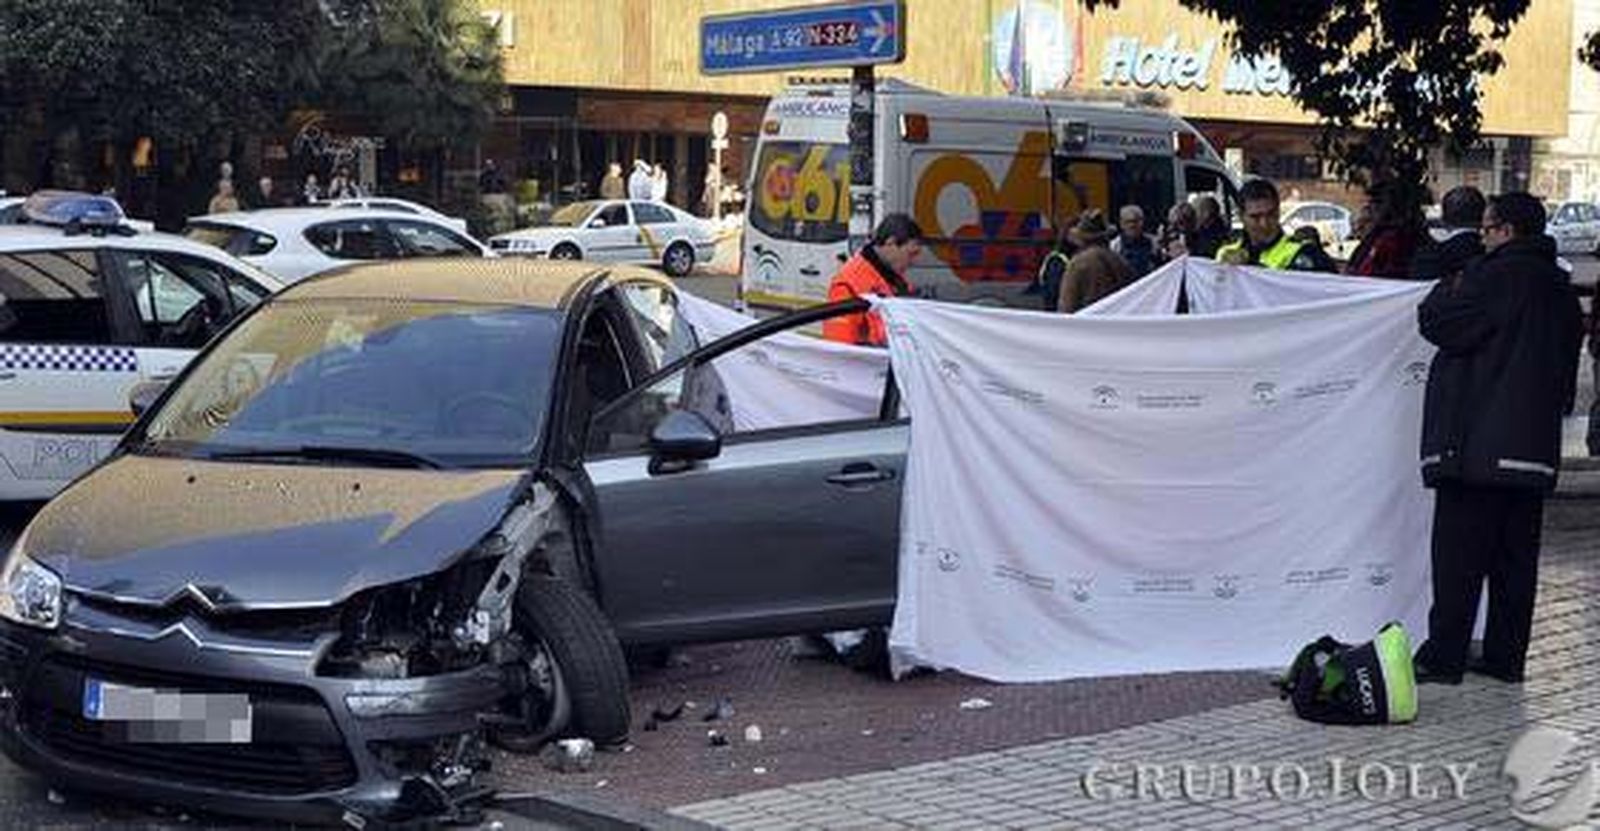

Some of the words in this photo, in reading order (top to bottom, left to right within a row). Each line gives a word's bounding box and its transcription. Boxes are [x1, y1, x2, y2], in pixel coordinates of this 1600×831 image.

[706, 32, 764, 58] Málaga
[806, 22, 858, 46] N-334
[1102, 35, 1217, 90] Hotel
